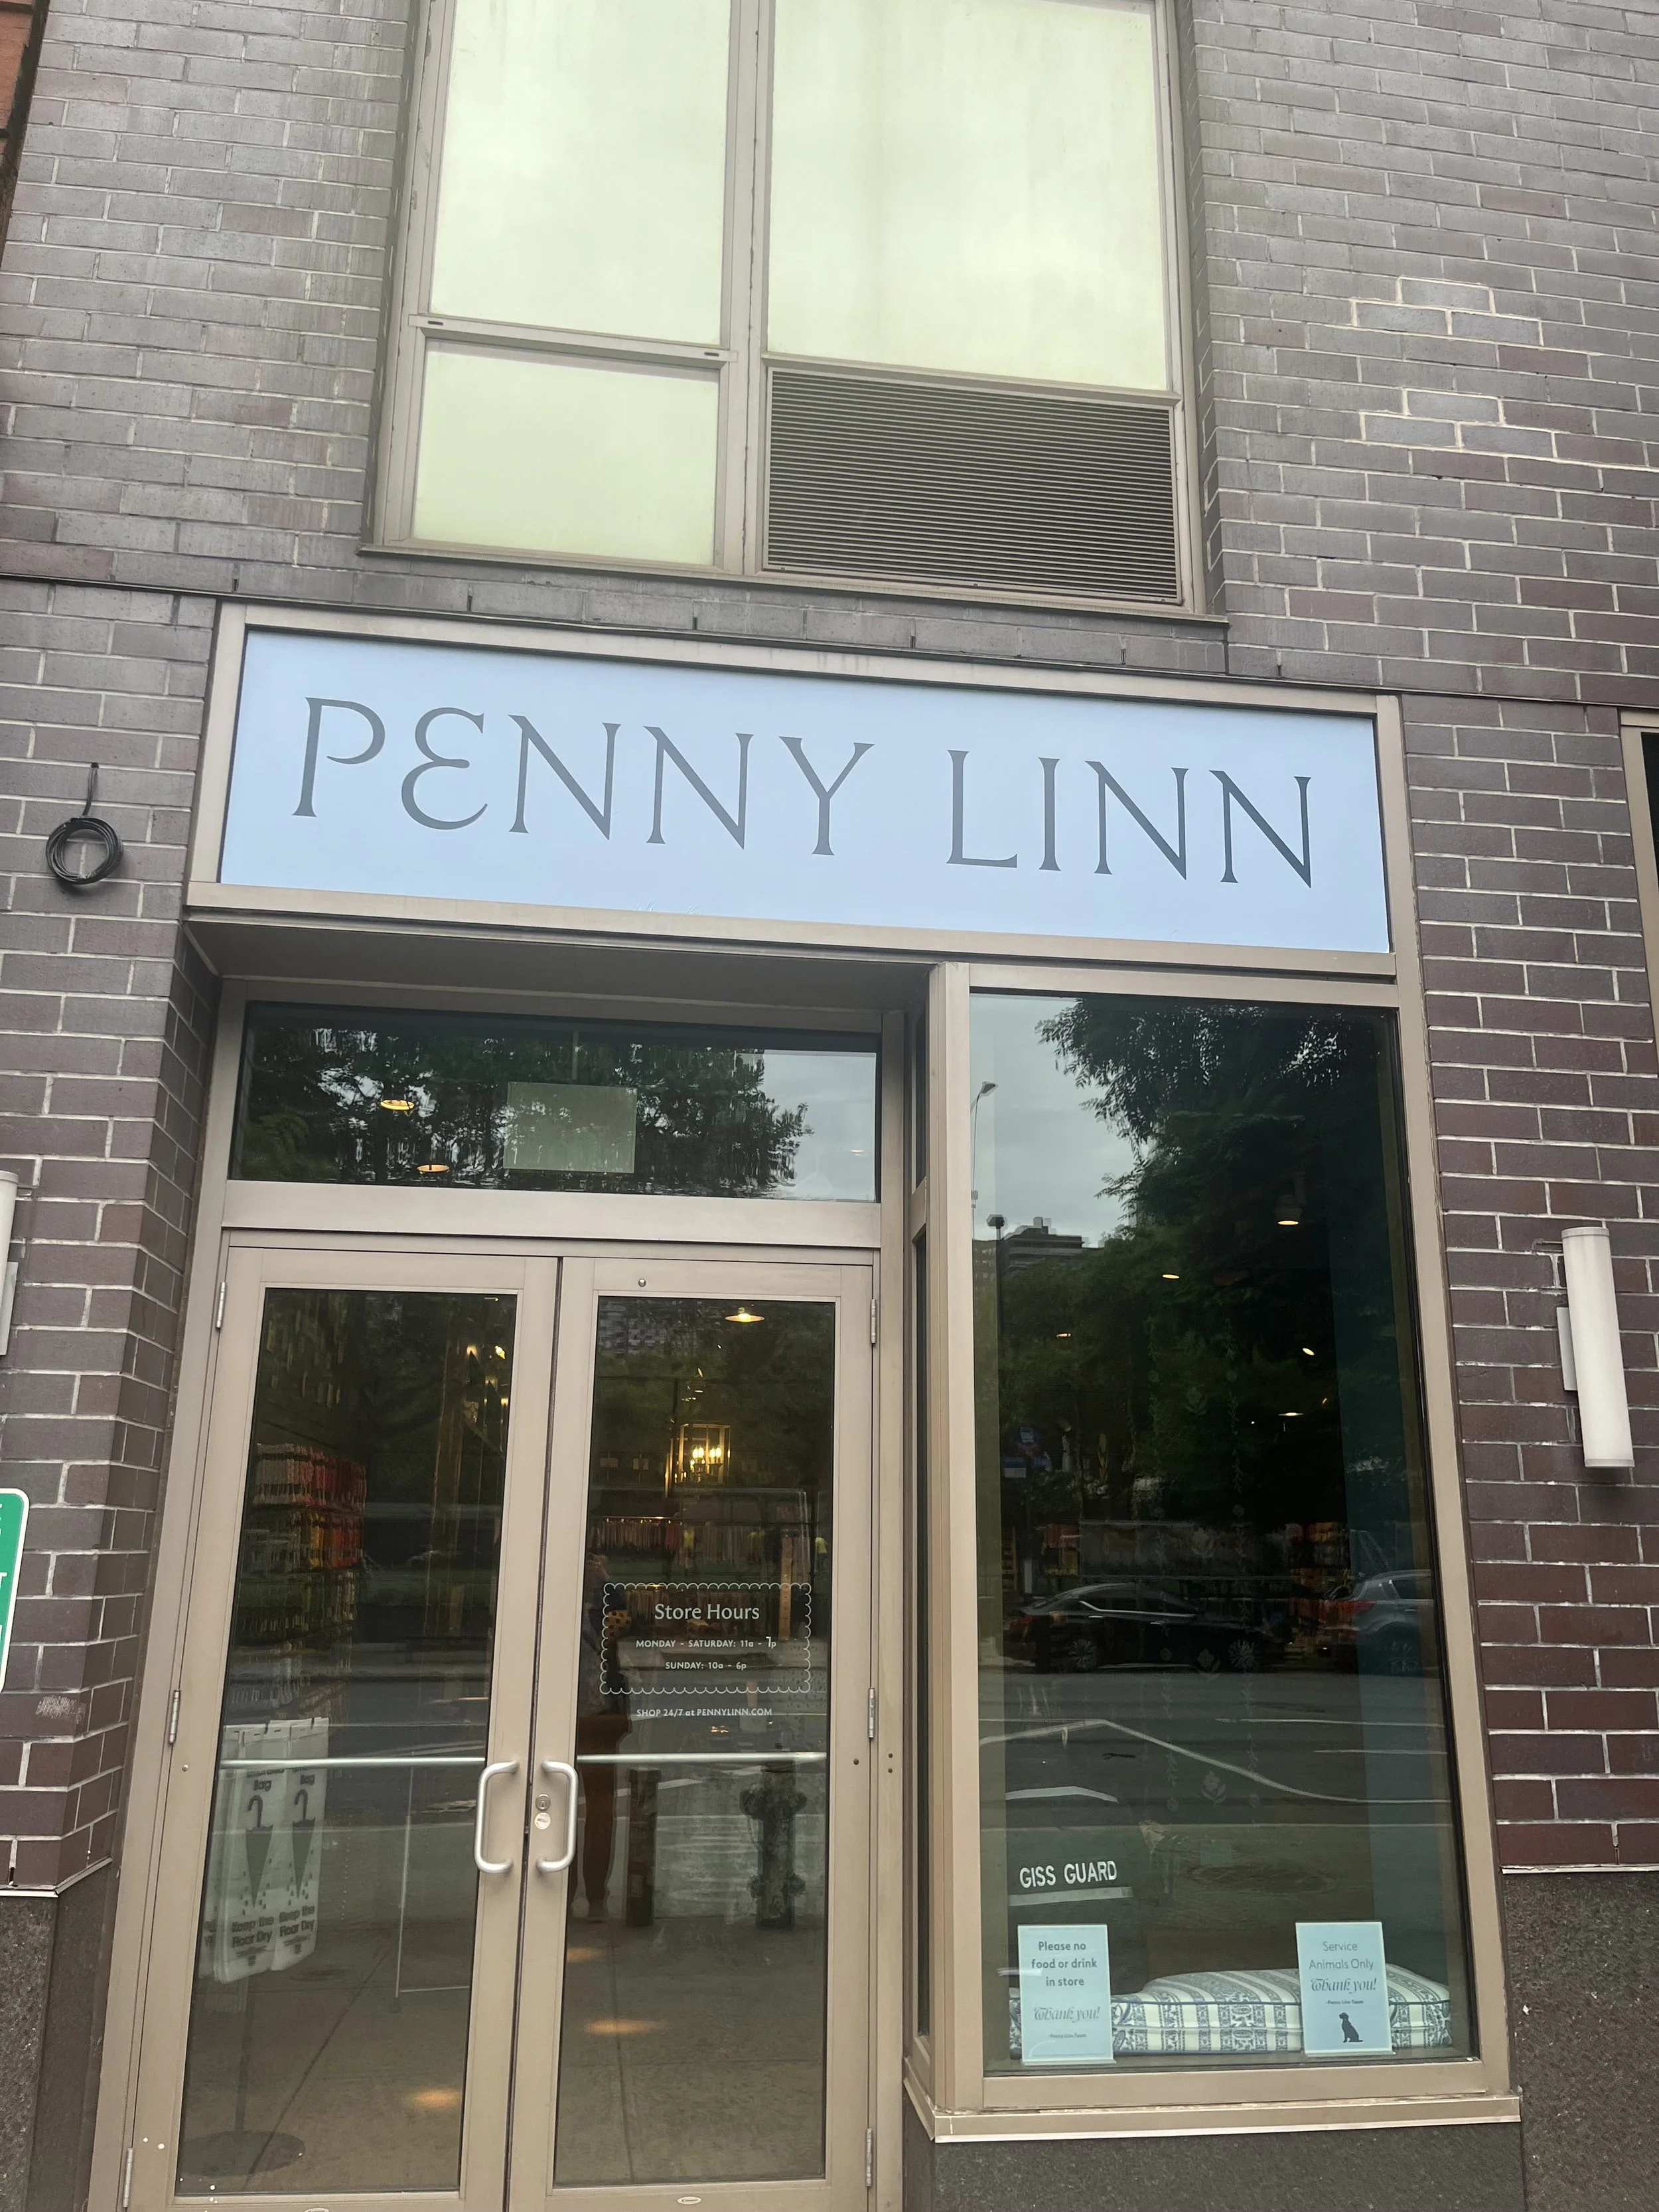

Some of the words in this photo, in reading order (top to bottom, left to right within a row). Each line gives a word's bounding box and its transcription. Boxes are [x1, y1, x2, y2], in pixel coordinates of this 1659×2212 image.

[291, 696, 876, 857] PENNY
[946, 749, 1313, 889] LINN
[654, 1603, 701, 1619] Store
[707, 1603, 760, 1619] Hours
[736, 1661, 747, 1670] 6p
[663, 1708, 684, 1718] 24/7
[697, 1708, 772, 1716] PENNYLINN.COM
[1019, 1865, 1056, 1888] GISS
[1064, 1860, 1118, 1884] GUARD
[1039, 1941, 1070, 1951] Please
[1323, 1941, 1358, 1951] Service
[1031, 1959, 1056, 1968] food
[1071, 1958, 1097, 1968] drink
[1309, 1958, 1348, 1969] Animals
[1350, 1958, 1374, 1971] Only
[1046, 1976, 1055, 1986] in
[1058, 1977, 1084, 1986] store
[1311, 1978, 1350, 1992] Thank
[1348, 1978, 1376, 1994] you!
[1034, 2007, 1074, 2021] Thank
[1072, 2006, 1100, 2023] you!
